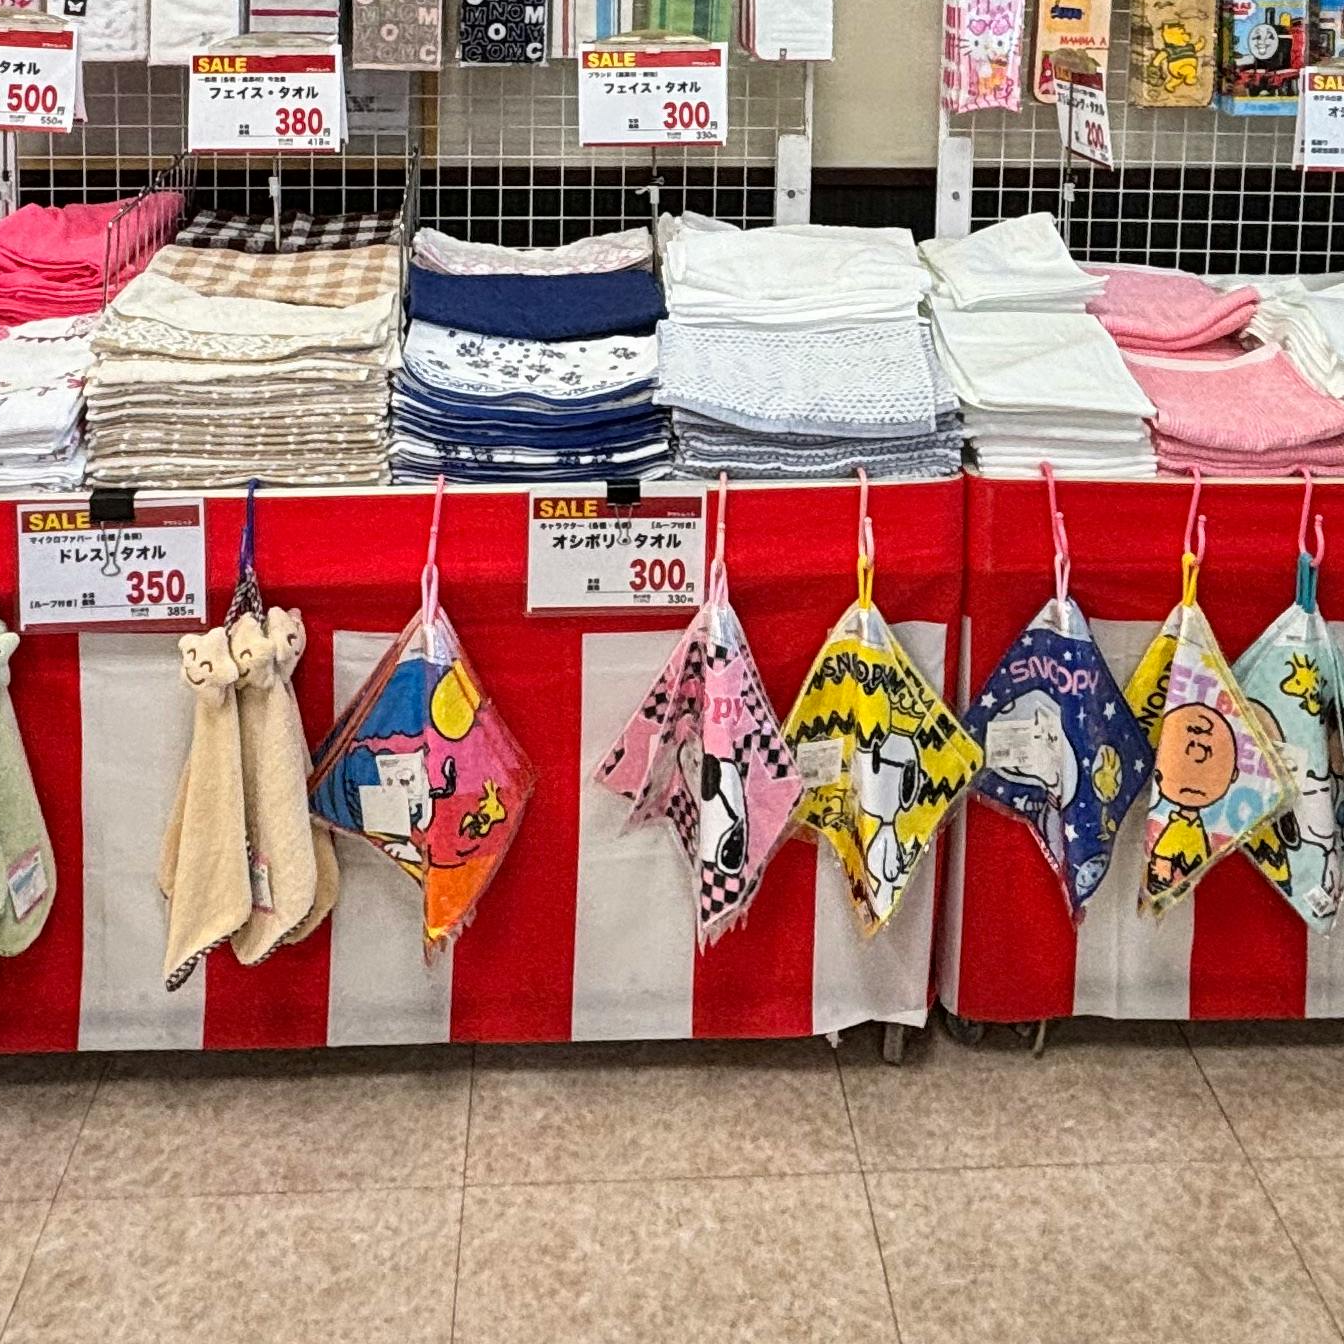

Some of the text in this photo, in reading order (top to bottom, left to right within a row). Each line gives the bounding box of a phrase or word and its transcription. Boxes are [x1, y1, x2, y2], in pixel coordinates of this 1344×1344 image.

[198, 57, 247, 72] SALE
[587, 52, 636, 68] SALE
[209, 86, 320, 99] フェイス・タオル
[604, 81, 702, 94] フェイス・タオル
[539, 500, 598, 517] SALE
[29, 511, 91, 531] SALE
[552, 534, 682, 550] オシボリ・タオル
[60, 545, 167, 564] ドレス・タオル
